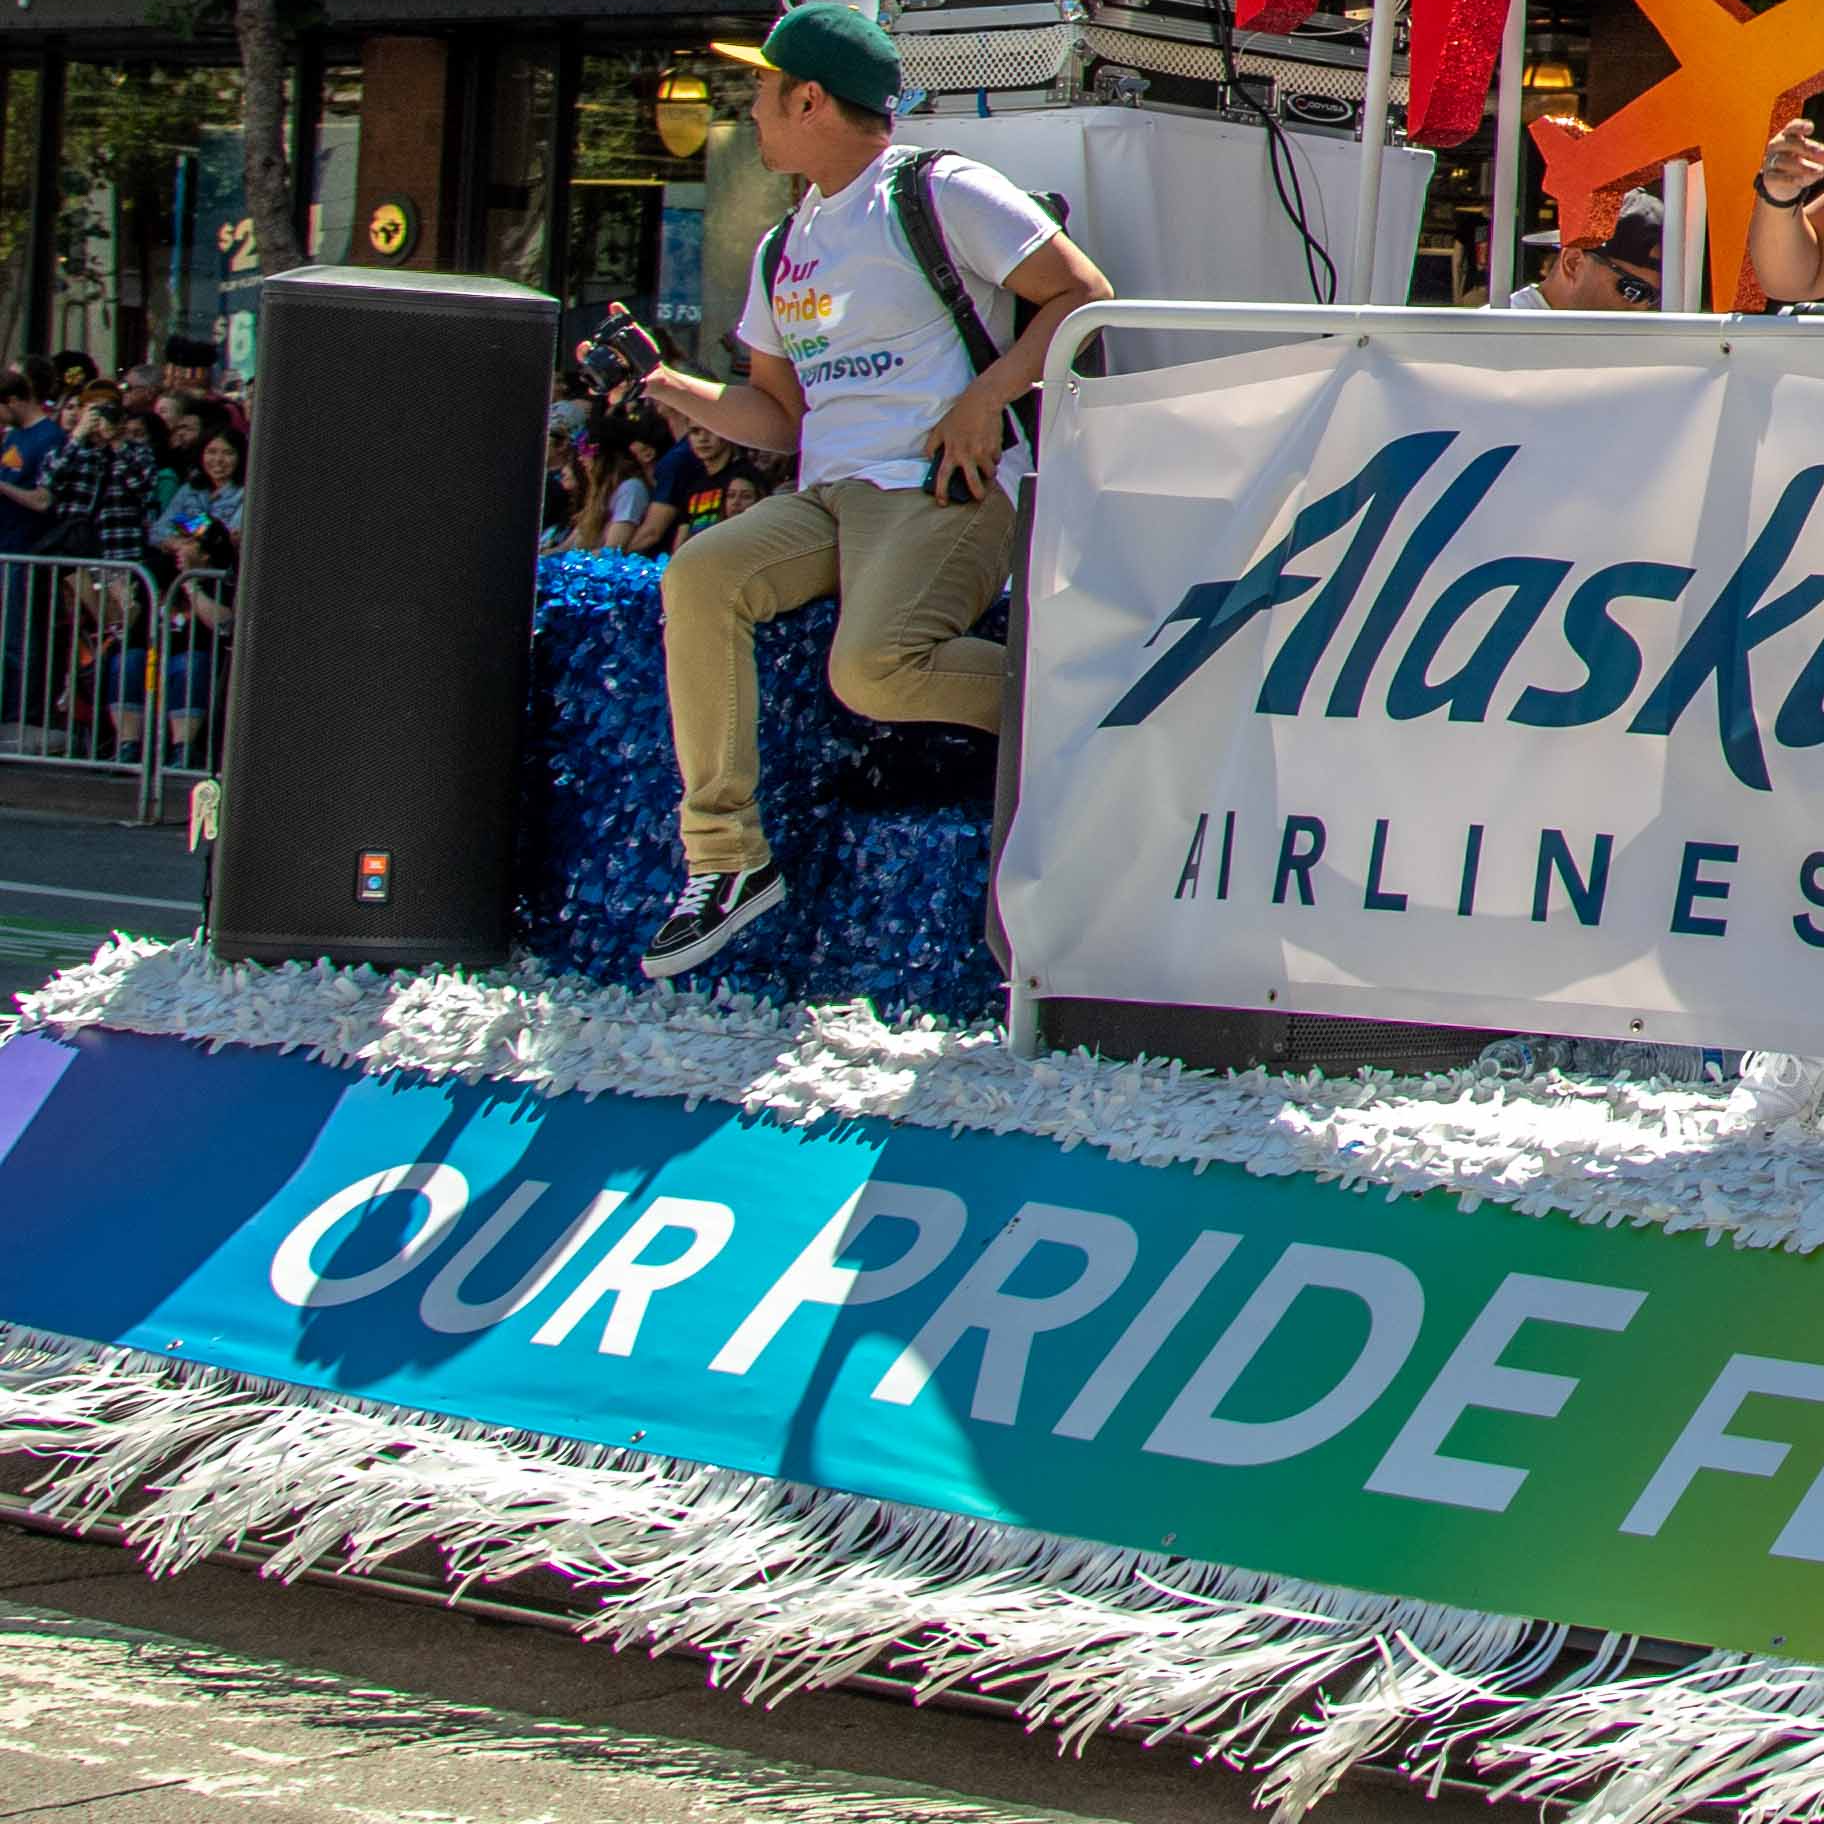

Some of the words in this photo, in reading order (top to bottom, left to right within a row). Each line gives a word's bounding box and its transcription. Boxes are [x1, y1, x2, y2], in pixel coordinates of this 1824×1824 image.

[773, 287, 833, 323] Pride
[783, 333, 830, 363] lies
[799, 349, 904, 388] onstop.
[267, 1161, 736, 1359] OUR
[706, 1179, 1651, 1514] PRIDE
